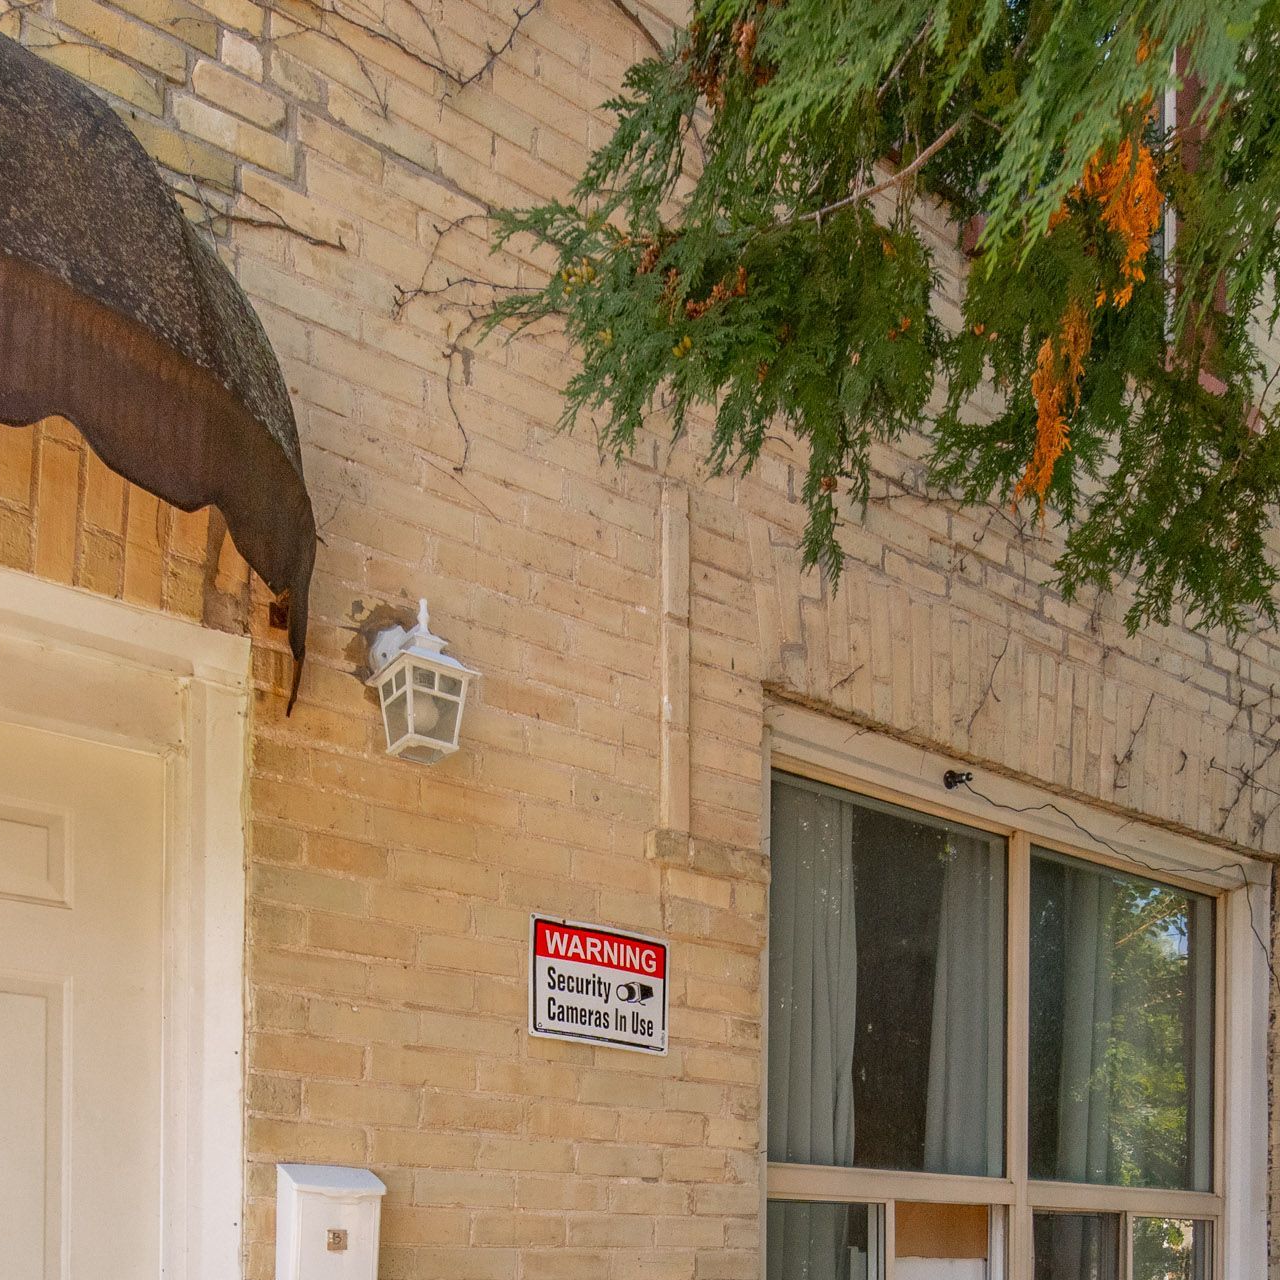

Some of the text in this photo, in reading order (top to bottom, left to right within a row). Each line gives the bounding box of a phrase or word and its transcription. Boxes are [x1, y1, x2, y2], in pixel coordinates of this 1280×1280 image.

[545, 929, 657, 973] WARNING
[547, 966, 611, 1004] Security
[547, 996, 610, 1029] Cameras
[615, 1008, 627, 1032] In
[631, 1011, 654, 1037] Use
